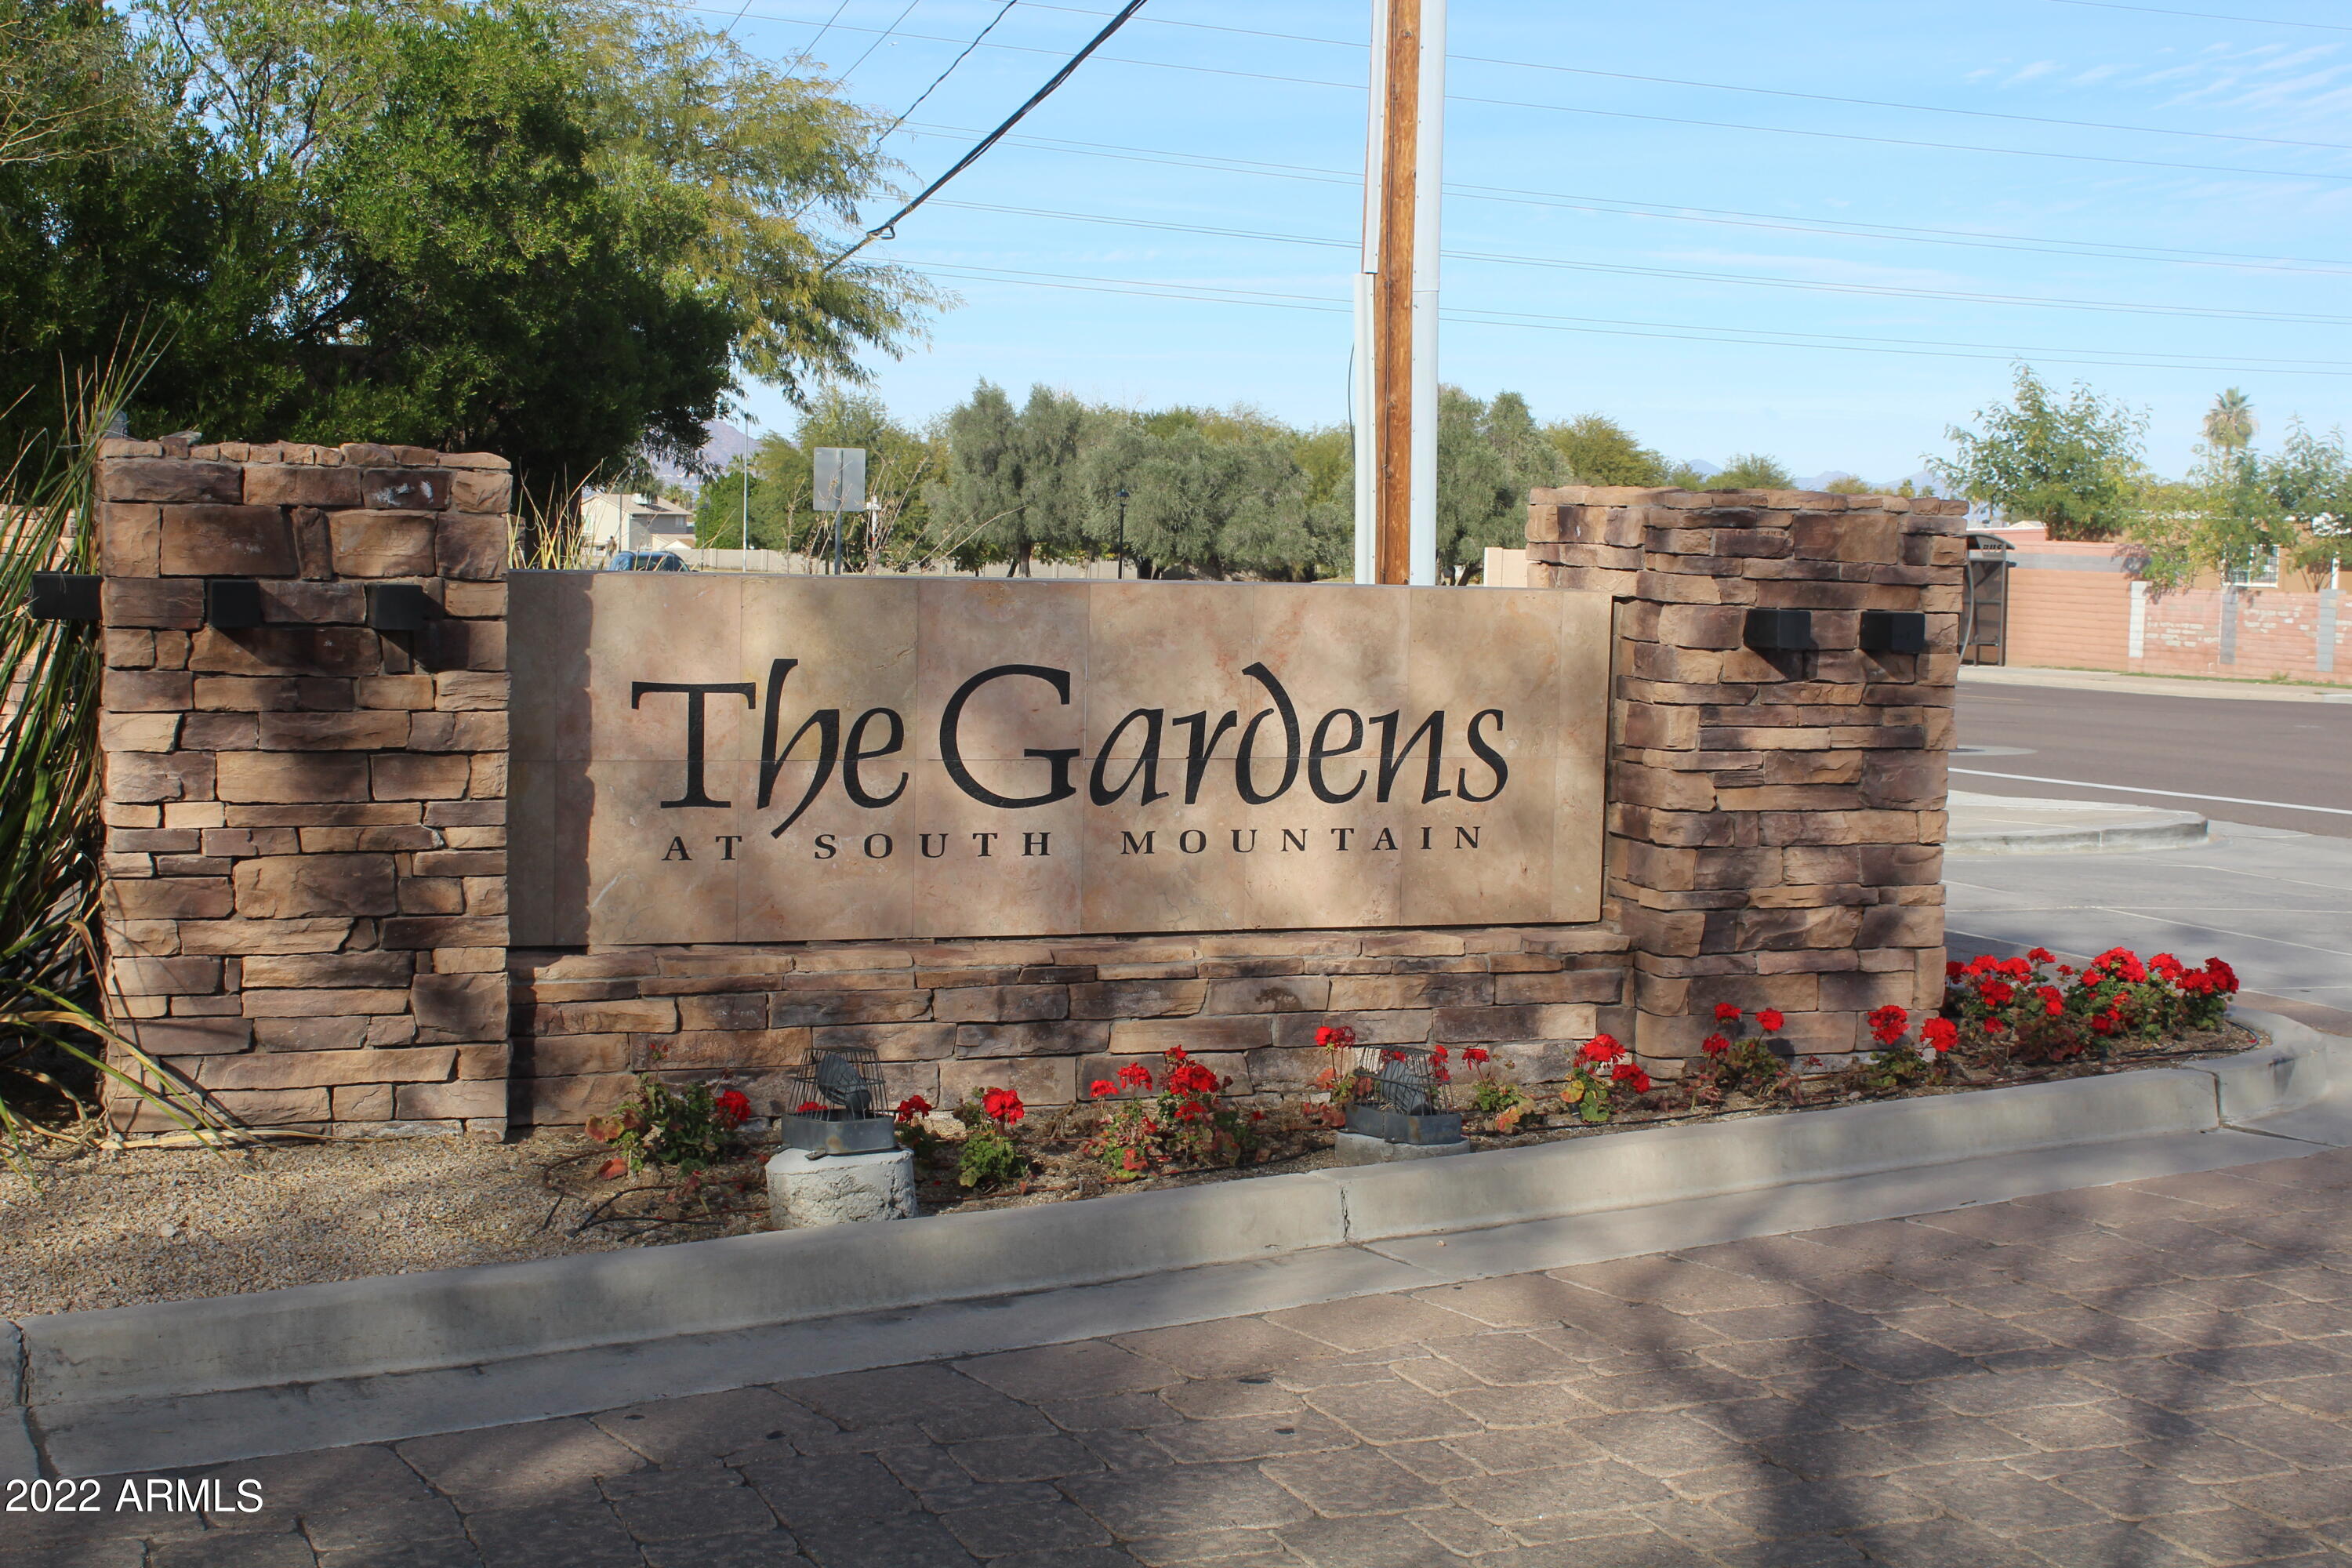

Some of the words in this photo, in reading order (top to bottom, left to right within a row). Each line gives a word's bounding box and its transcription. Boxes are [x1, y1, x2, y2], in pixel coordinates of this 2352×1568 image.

[631, 659, 909, 840] The
[939, 661, 1509, 809] Gardens
[661, 835, 743, 861] AT
[814, 832, 1052, 859] SOUTH
[1120, 826, 1481, 855] MOUNTAIN
